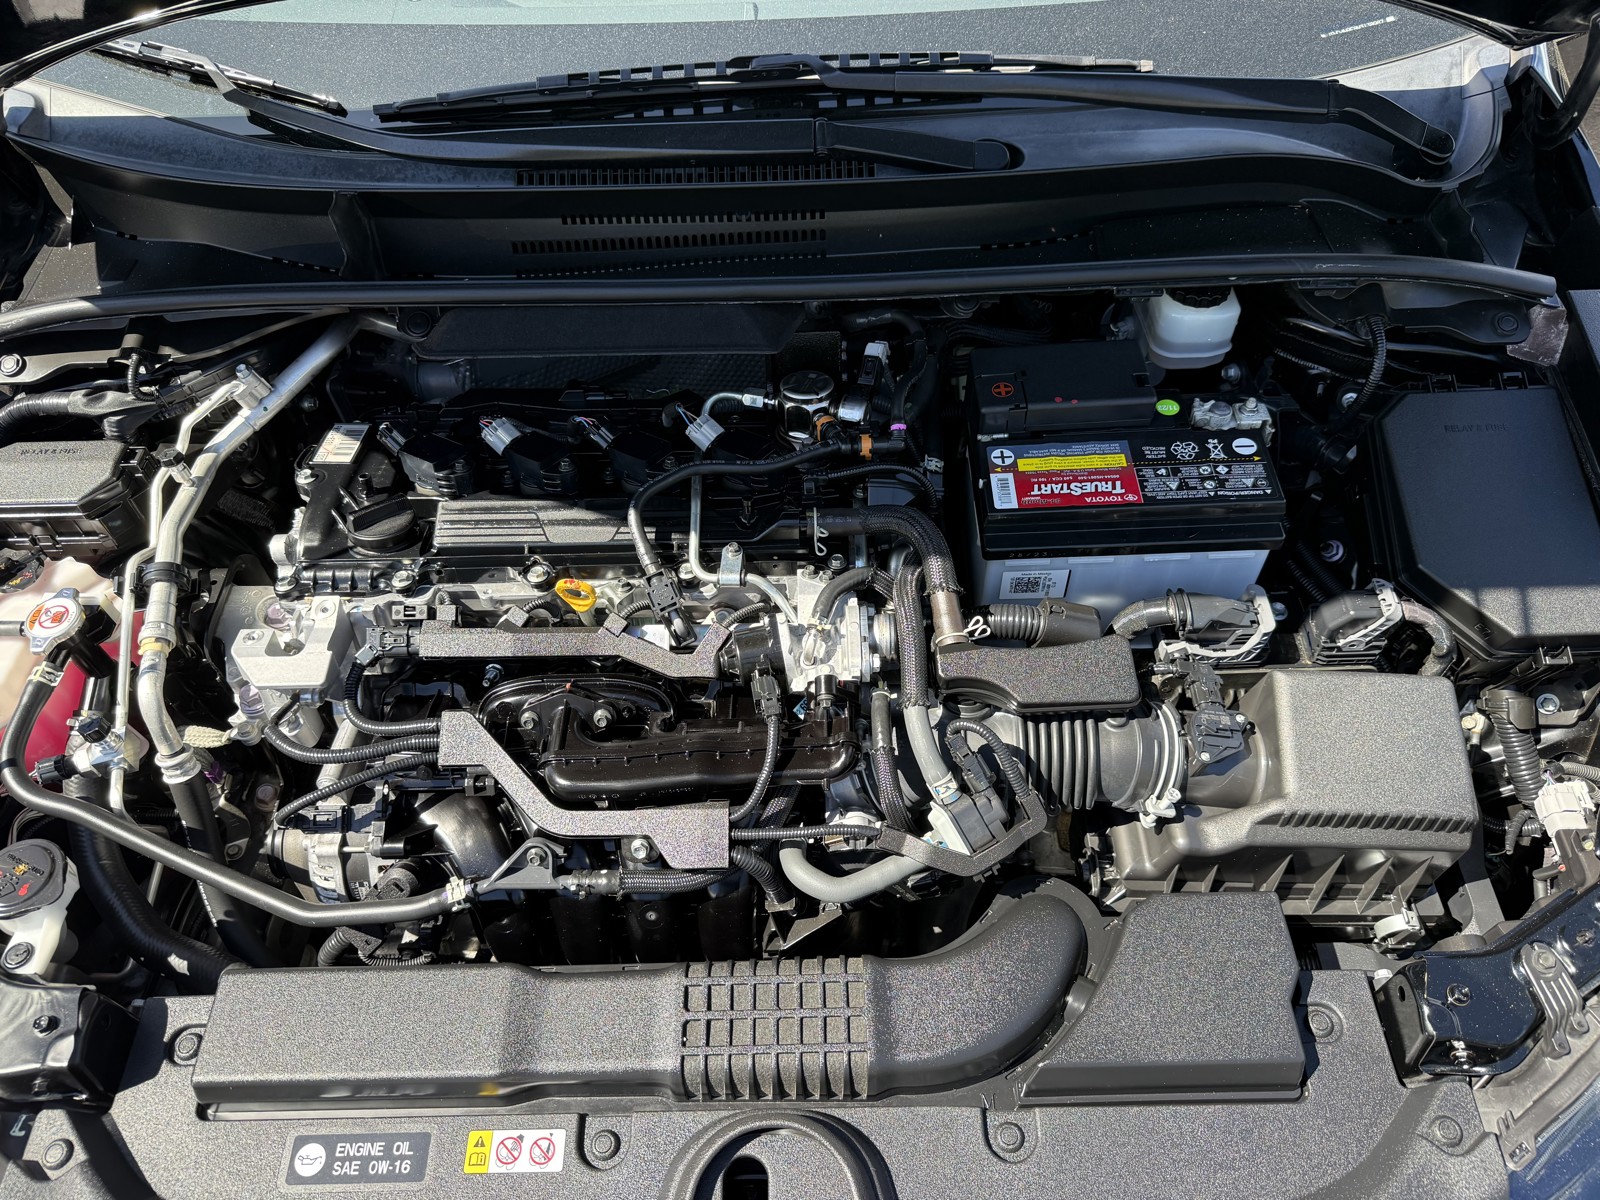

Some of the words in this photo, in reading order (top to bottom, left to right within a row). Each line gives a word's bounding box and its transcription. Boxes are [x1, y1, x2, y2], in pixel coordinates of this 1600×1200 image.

[1444, 424, 1472, 432] RELAY
[336, 1142, 384, 1156] ENGINE
[392, 1141, 414, 1156] OIL
[332, 1161, 359, 1175] SAE
[369, 1160, 411, 1175] 0W-16
